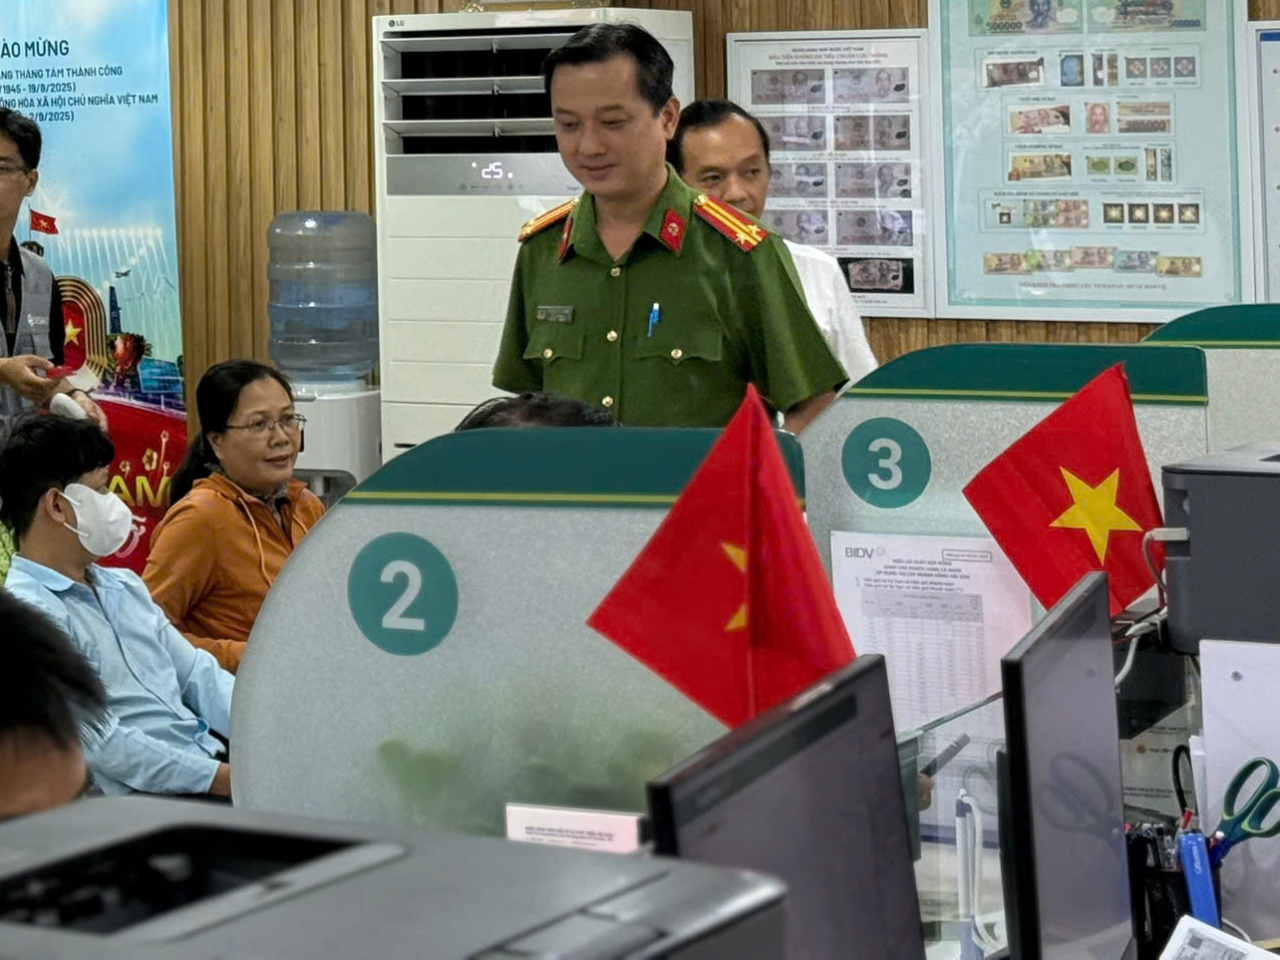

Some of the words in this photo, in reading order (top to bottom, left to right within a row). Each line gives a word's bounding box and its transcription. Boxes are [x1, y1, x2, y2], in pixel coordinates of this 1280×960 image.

[24, 37, 69, 58] MỪNG
[98, 64, 123, 76] CÔNG
[28, 82, 77, 94] 19/8/2025)
[18, 96, 35, 108] HÒA
[37, 95, 50, 108] XÃ
[51, 95, 66, 109] HỘI
[68, 93, 86, 107] CHỦ
[88, 94, 115, 106] NGHĨA
[117, 93, 137, 107] VIỆT
[138, 94, 158, 104] NAM
[867, 437, 903, 491] 3
[108, 475, 172, 508] AM
[845, 546, 875, 559] BIDV
[379, 559, 426, 632] 2
